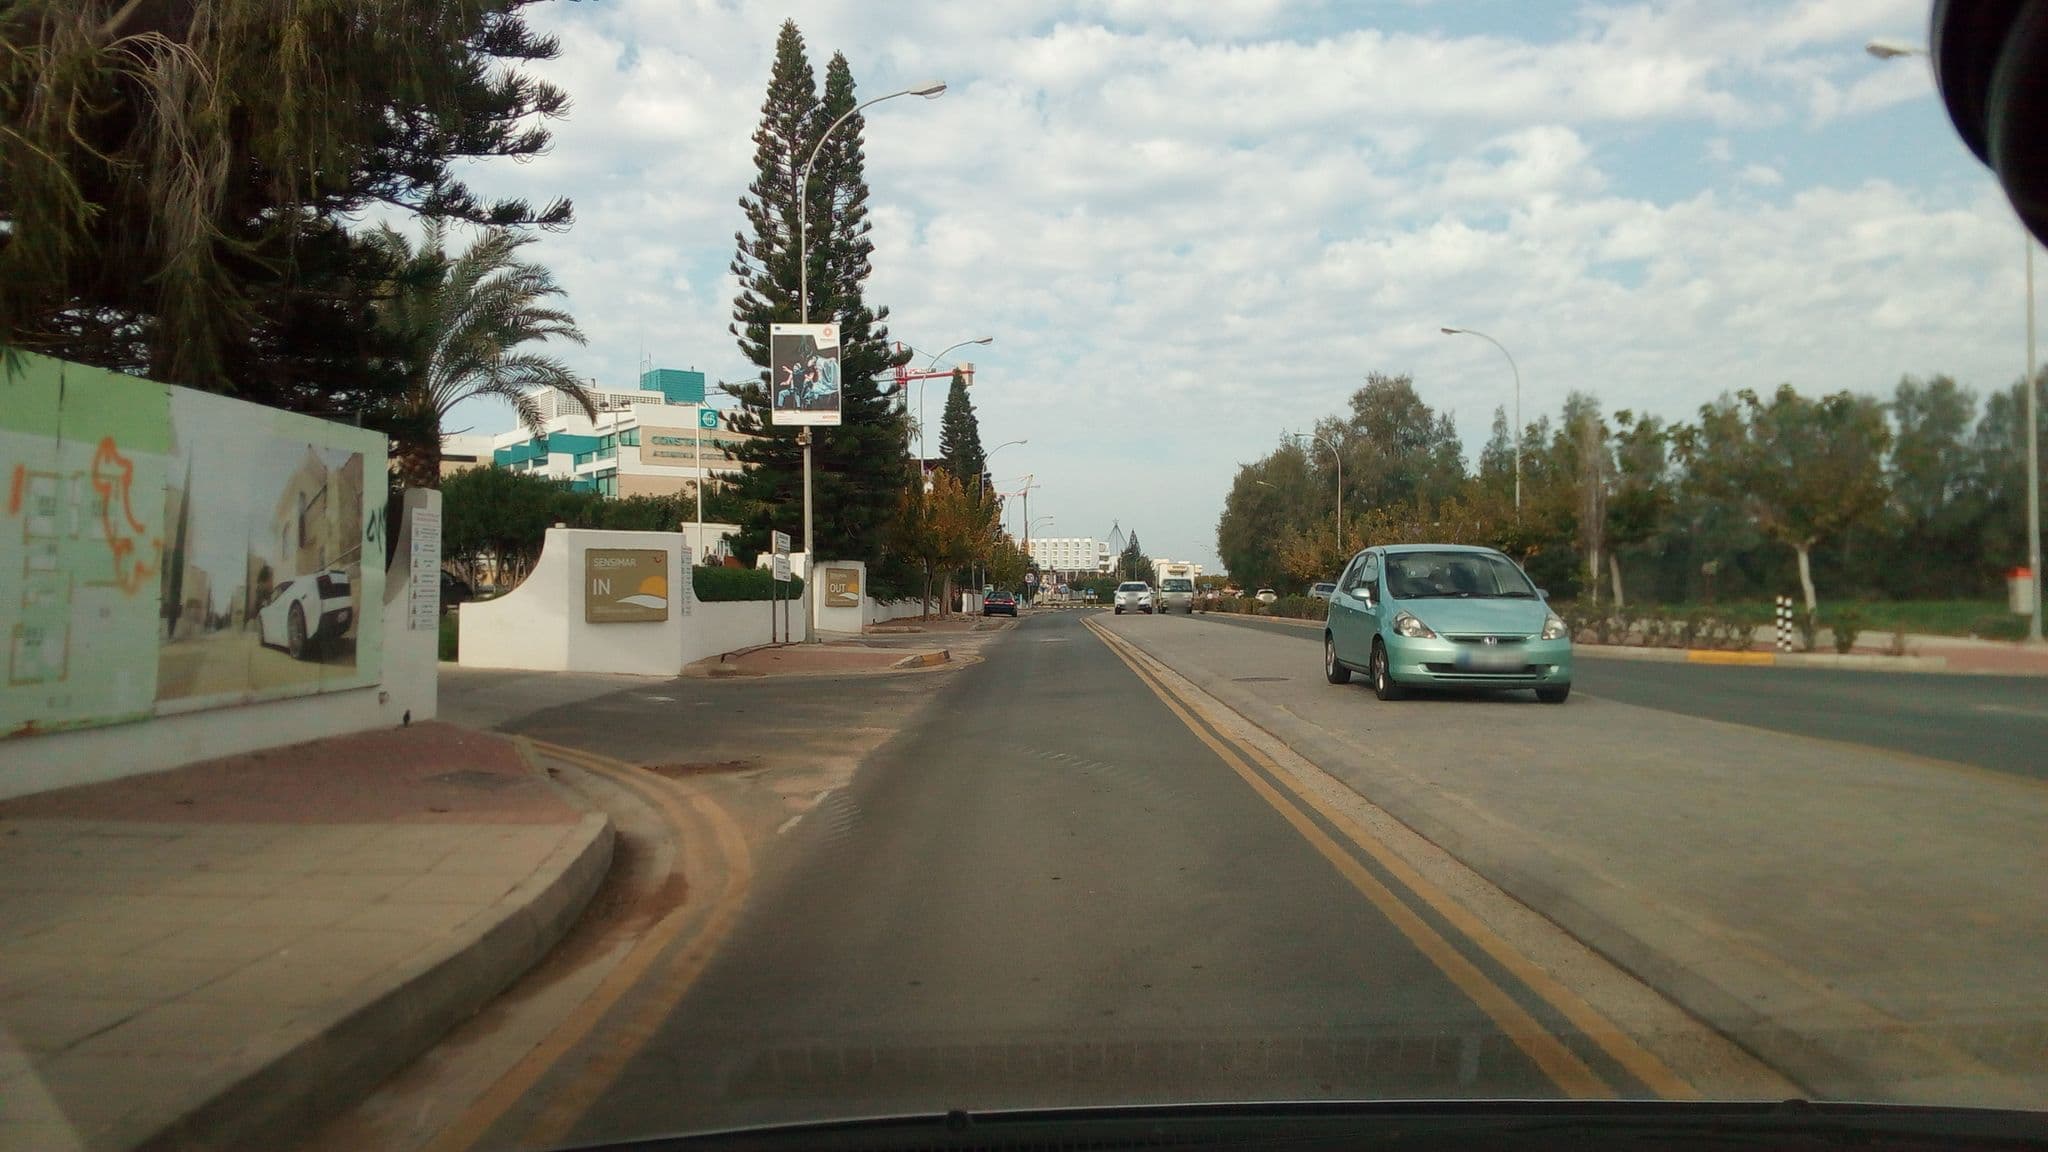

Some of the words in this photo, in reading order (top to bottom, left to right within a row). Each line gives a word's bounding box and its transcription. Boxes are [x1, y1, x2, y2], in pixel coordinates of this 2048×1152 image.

[593, 557, 637, 567] SENSIMAR
[593, 578, 611, 595] IN
[829, 583, 847, 593] OUT
